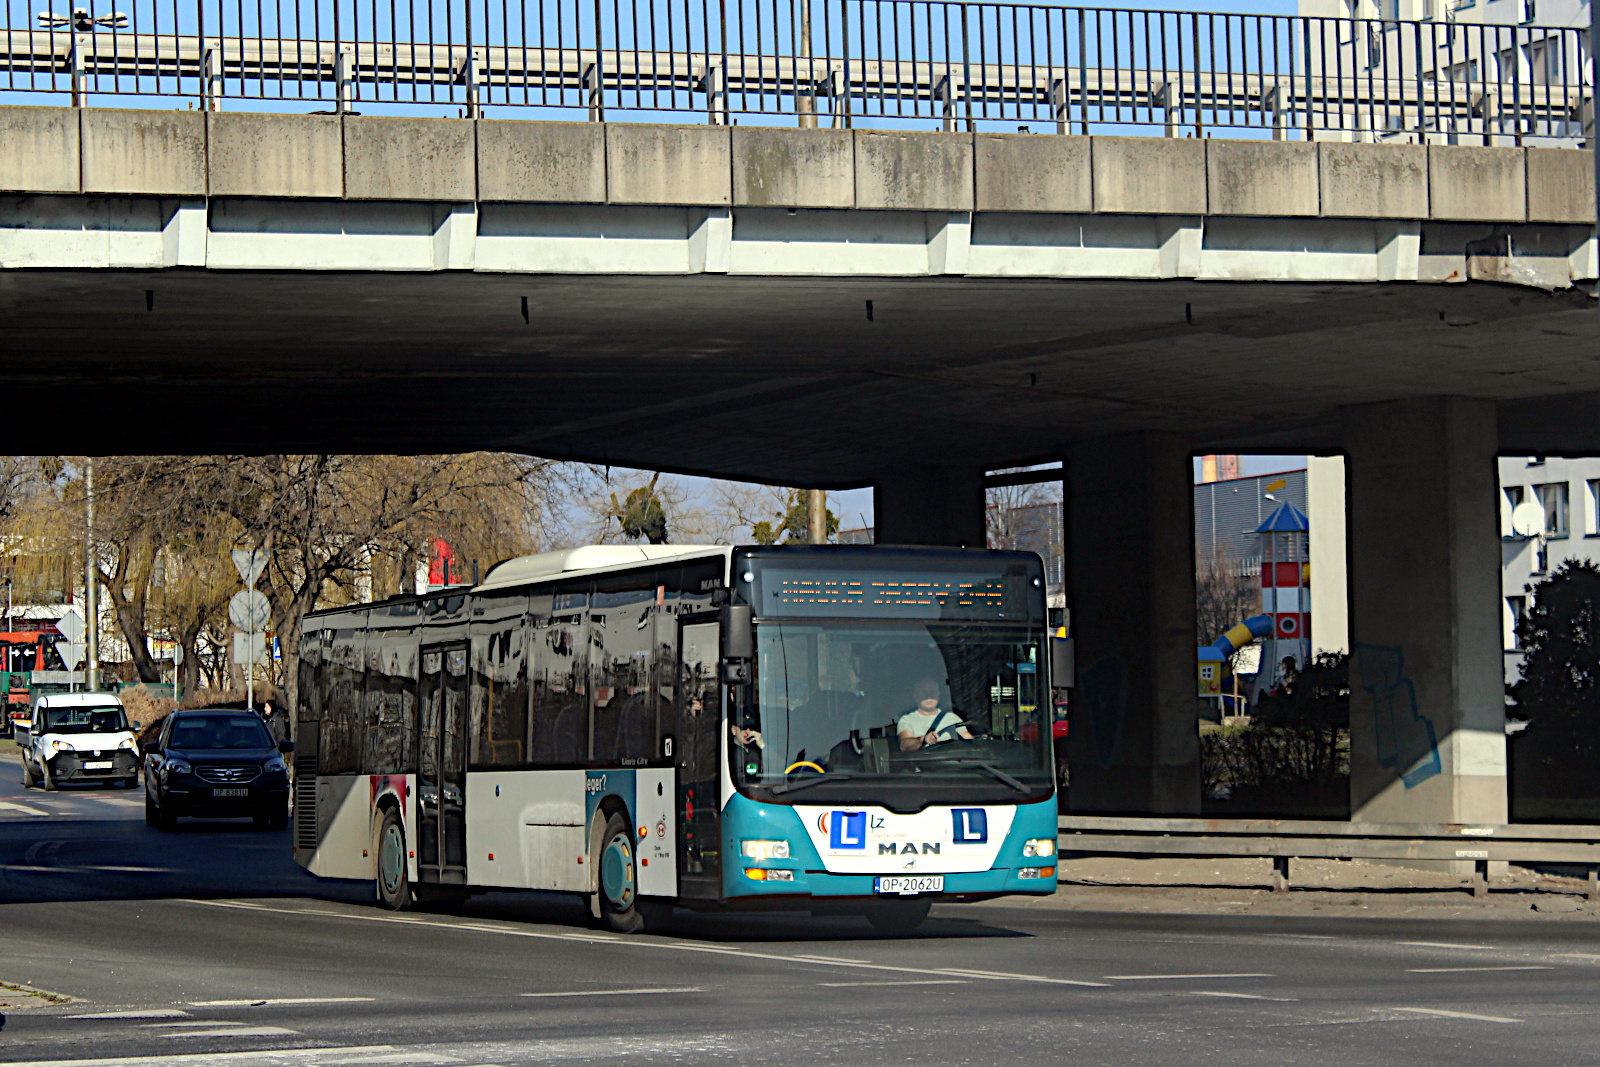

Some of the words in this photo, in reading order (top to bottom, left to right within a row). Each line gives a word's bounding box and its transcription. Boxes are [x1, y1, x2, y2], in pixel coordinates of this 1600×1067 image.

[840, 815, 859, 845] L
[961, 811, 981, 840] L
[877, 842, 941, 855] MAN
[882, 878, 899, 892] OP
[903, 877, 941, 891] 2062U
